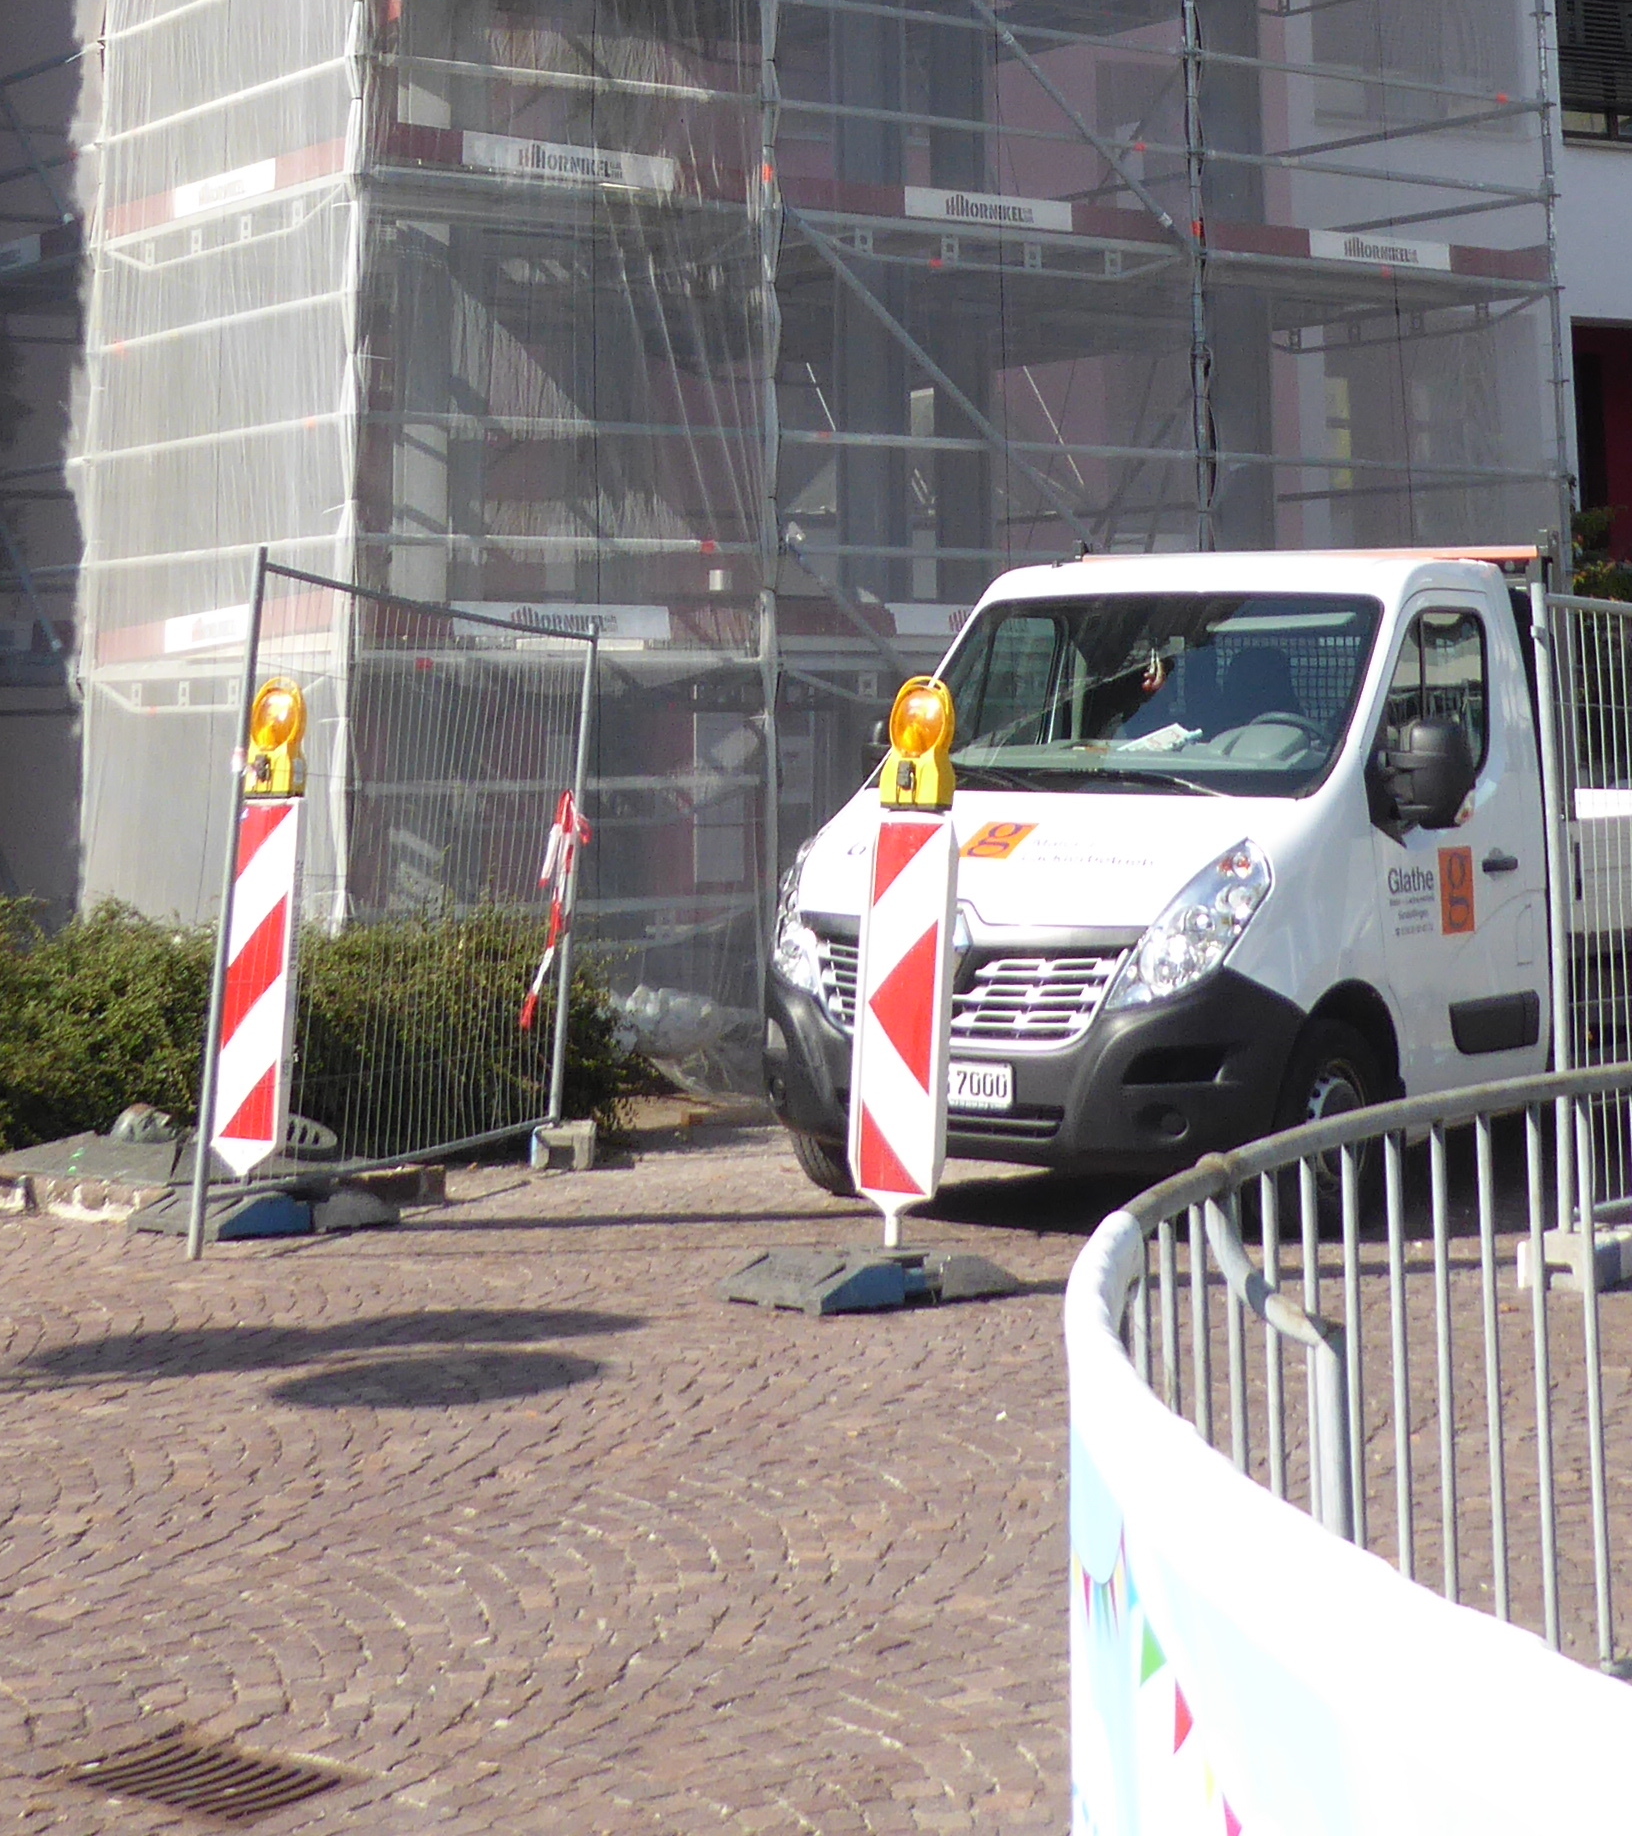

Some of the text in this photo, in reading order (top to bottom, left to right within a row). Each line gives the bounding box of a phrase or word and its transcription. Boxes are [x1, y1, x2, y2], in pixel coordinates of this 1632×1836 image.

[536, 145, 610, 177] HORNIKEL
[961, 195, 1024, 222] HORNIKEL
[1357, 238, 1410, 262] HORNIKEL
[1388, 866, 1434, 894] Glathe
[956, 1070, 1008, 1098] 7000
